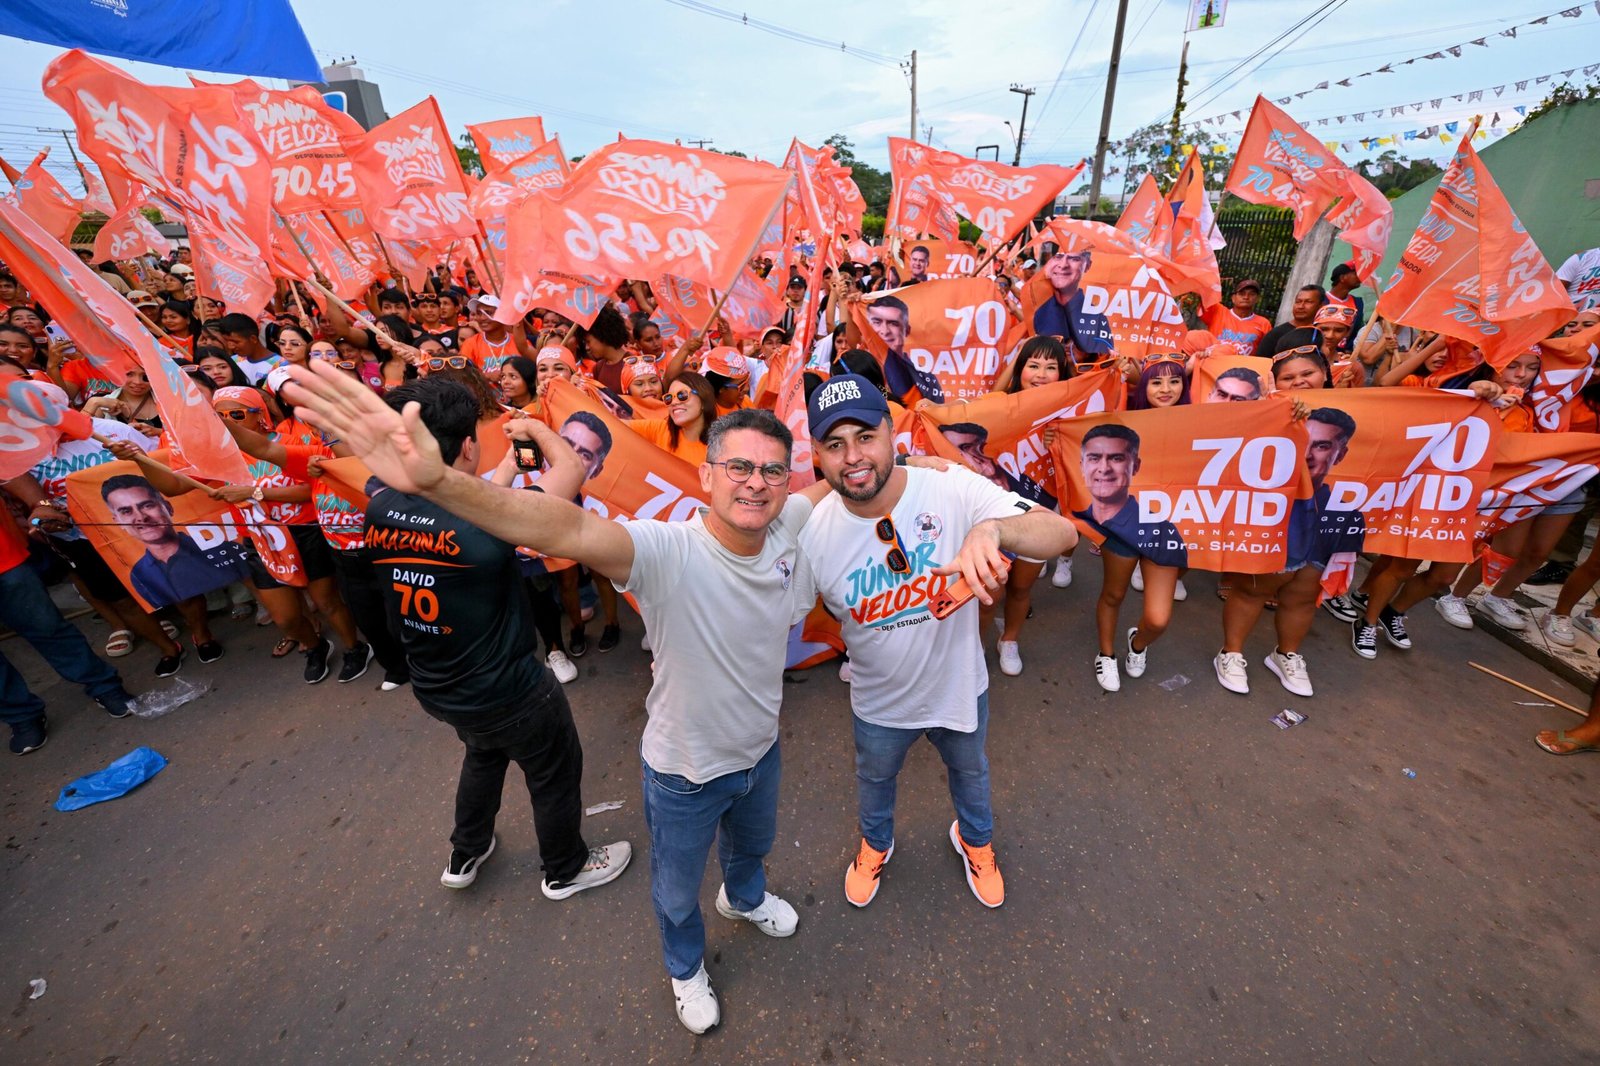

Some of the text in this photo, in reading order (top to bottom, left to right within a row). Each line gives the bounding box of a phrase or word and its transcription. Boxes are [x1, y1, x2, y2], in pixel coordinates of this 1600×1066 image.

[945, 253, 975, 274] 70
[1081, 285, 1185, 326] DAVID
[945, 300, 1007, 349] 70
[909, 347, 1000, 376] DAVID
[818, 379, 860, 402] JÚNIOR
[919, 372, 994, 386] GOVERNADO
[818, 389, 862, 412] VELOSO
[1402, 415, 1491, 478] 70
[1191, 436, 1297, 490] 70
[1325, 473, 1473, 513] DAVID
[387, 510, 436, 526] PRA CIMA
[1138, 490, 1288, 527] DAVID
[364, 524, 461, 556] AMAZONAS
[1138, 529, 1284, 539] GOVERNADOR
[1347, 526, 1382, 535] Dra.
[1389, 525, 1466, 541] SHÁDIA
[1167, 540, 1204, 550] Dra.
[1209, 540, 1282, 554] SHÁDIA
[393, 568, 436, 587] DAVID
[393, 582, 440, 623] 70
[850, 575, 948, 625] VELOSO
[404, 618, 440, 635] AVANTE
[881, 614, 931, 632] DEP. ESTADUAL
